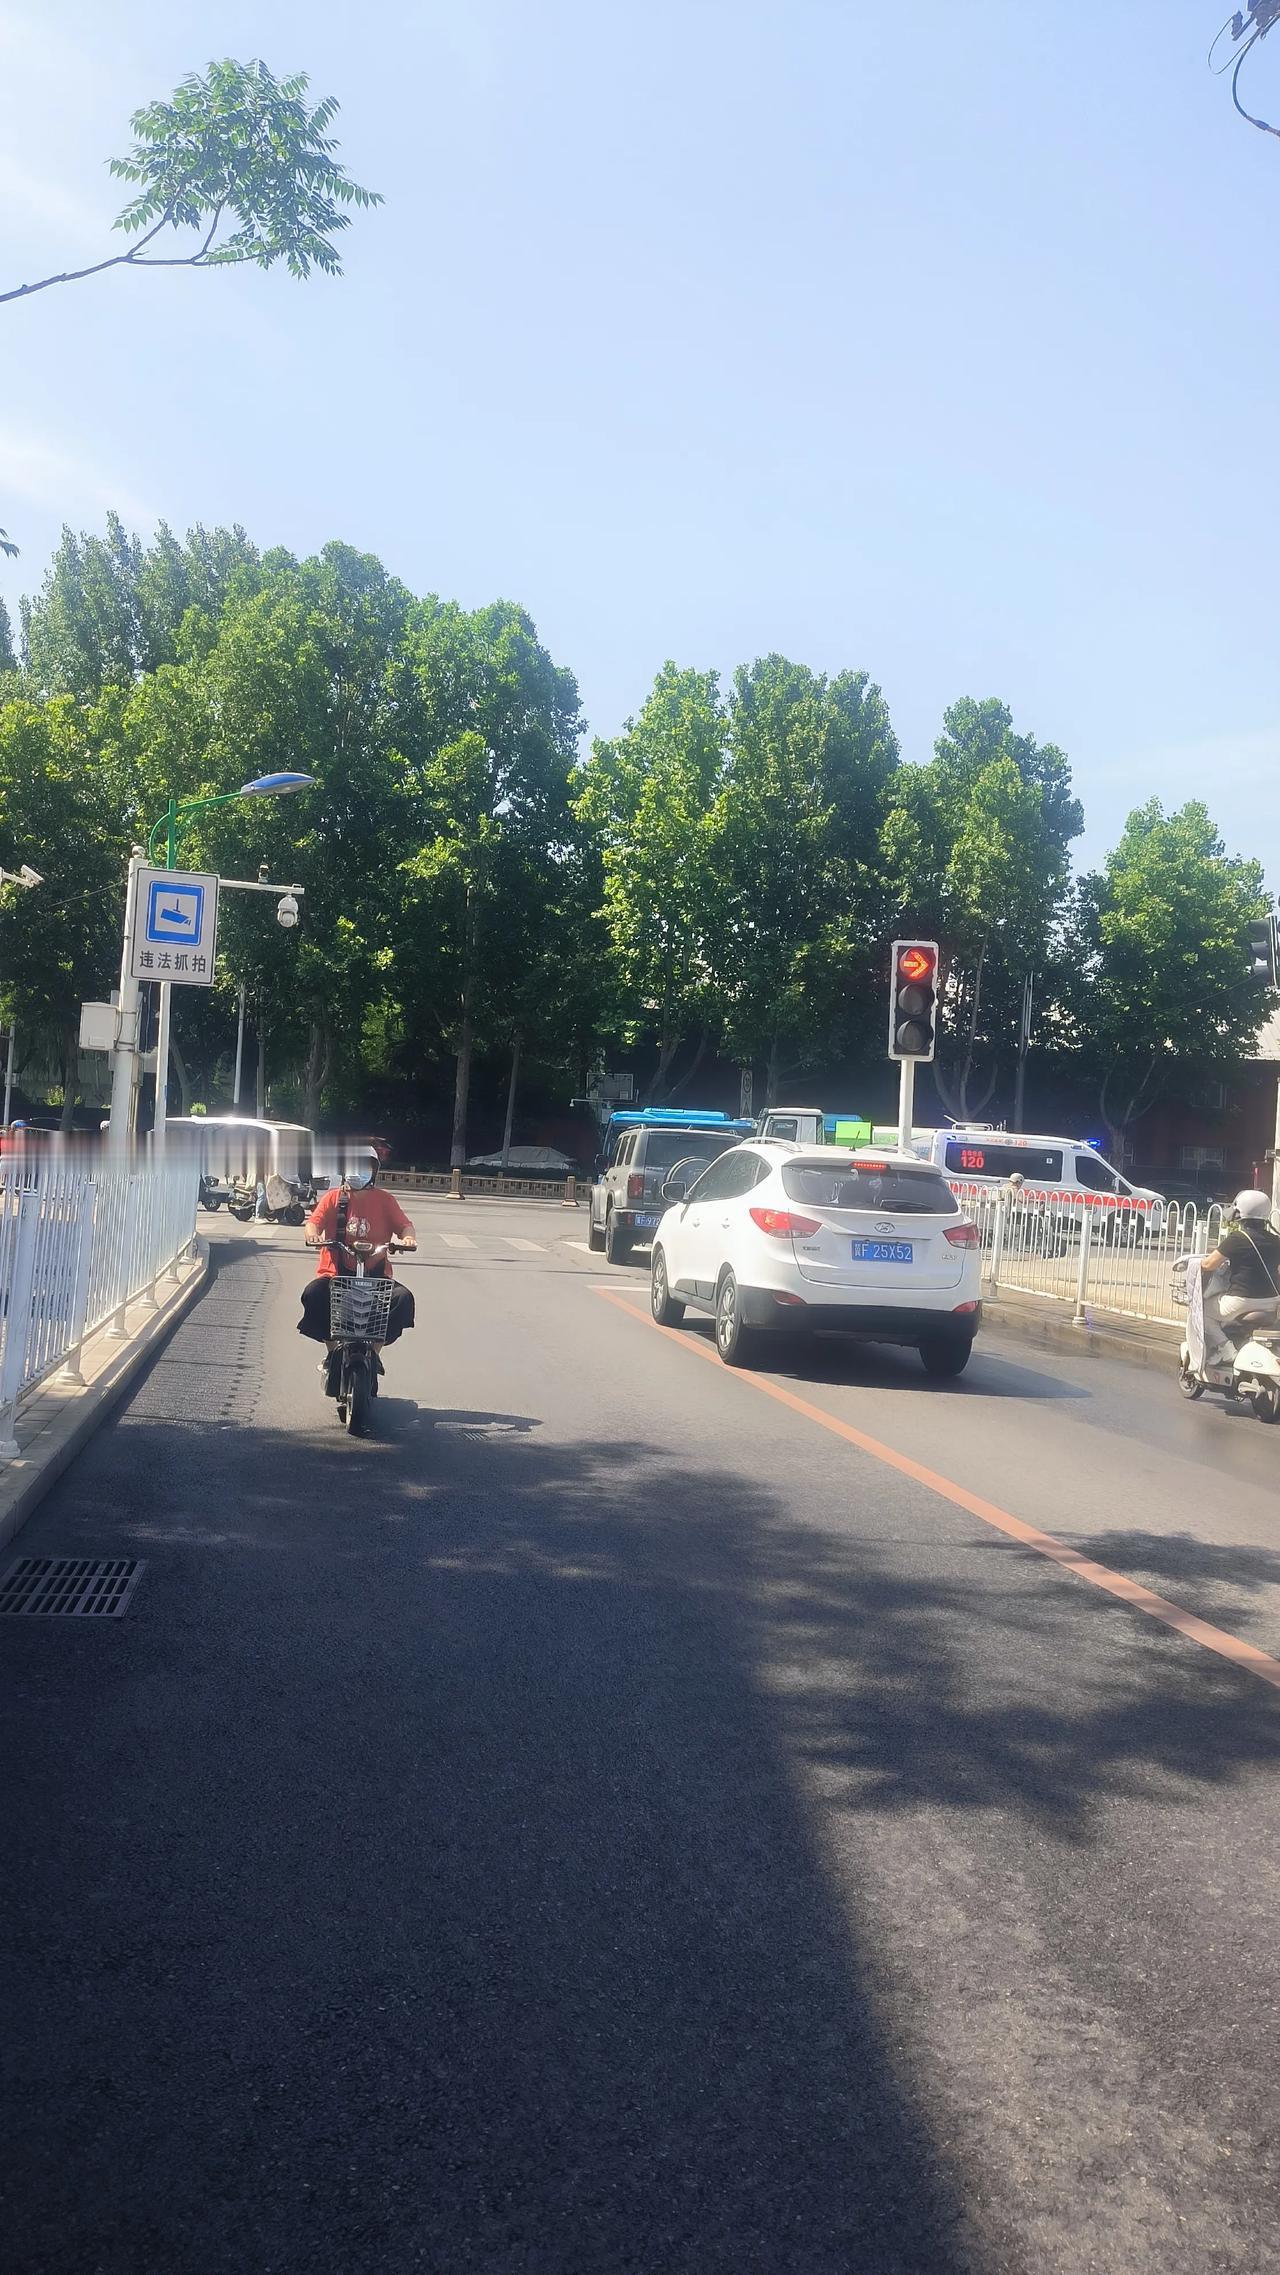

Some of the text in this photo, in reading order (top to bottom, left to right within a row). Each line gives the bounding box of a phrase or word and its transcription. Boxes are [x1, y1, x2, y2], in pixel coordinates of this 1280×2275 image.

[139, 950, 206, 973] 违法抓拍
[961, 1156, 984, 1168] 120
